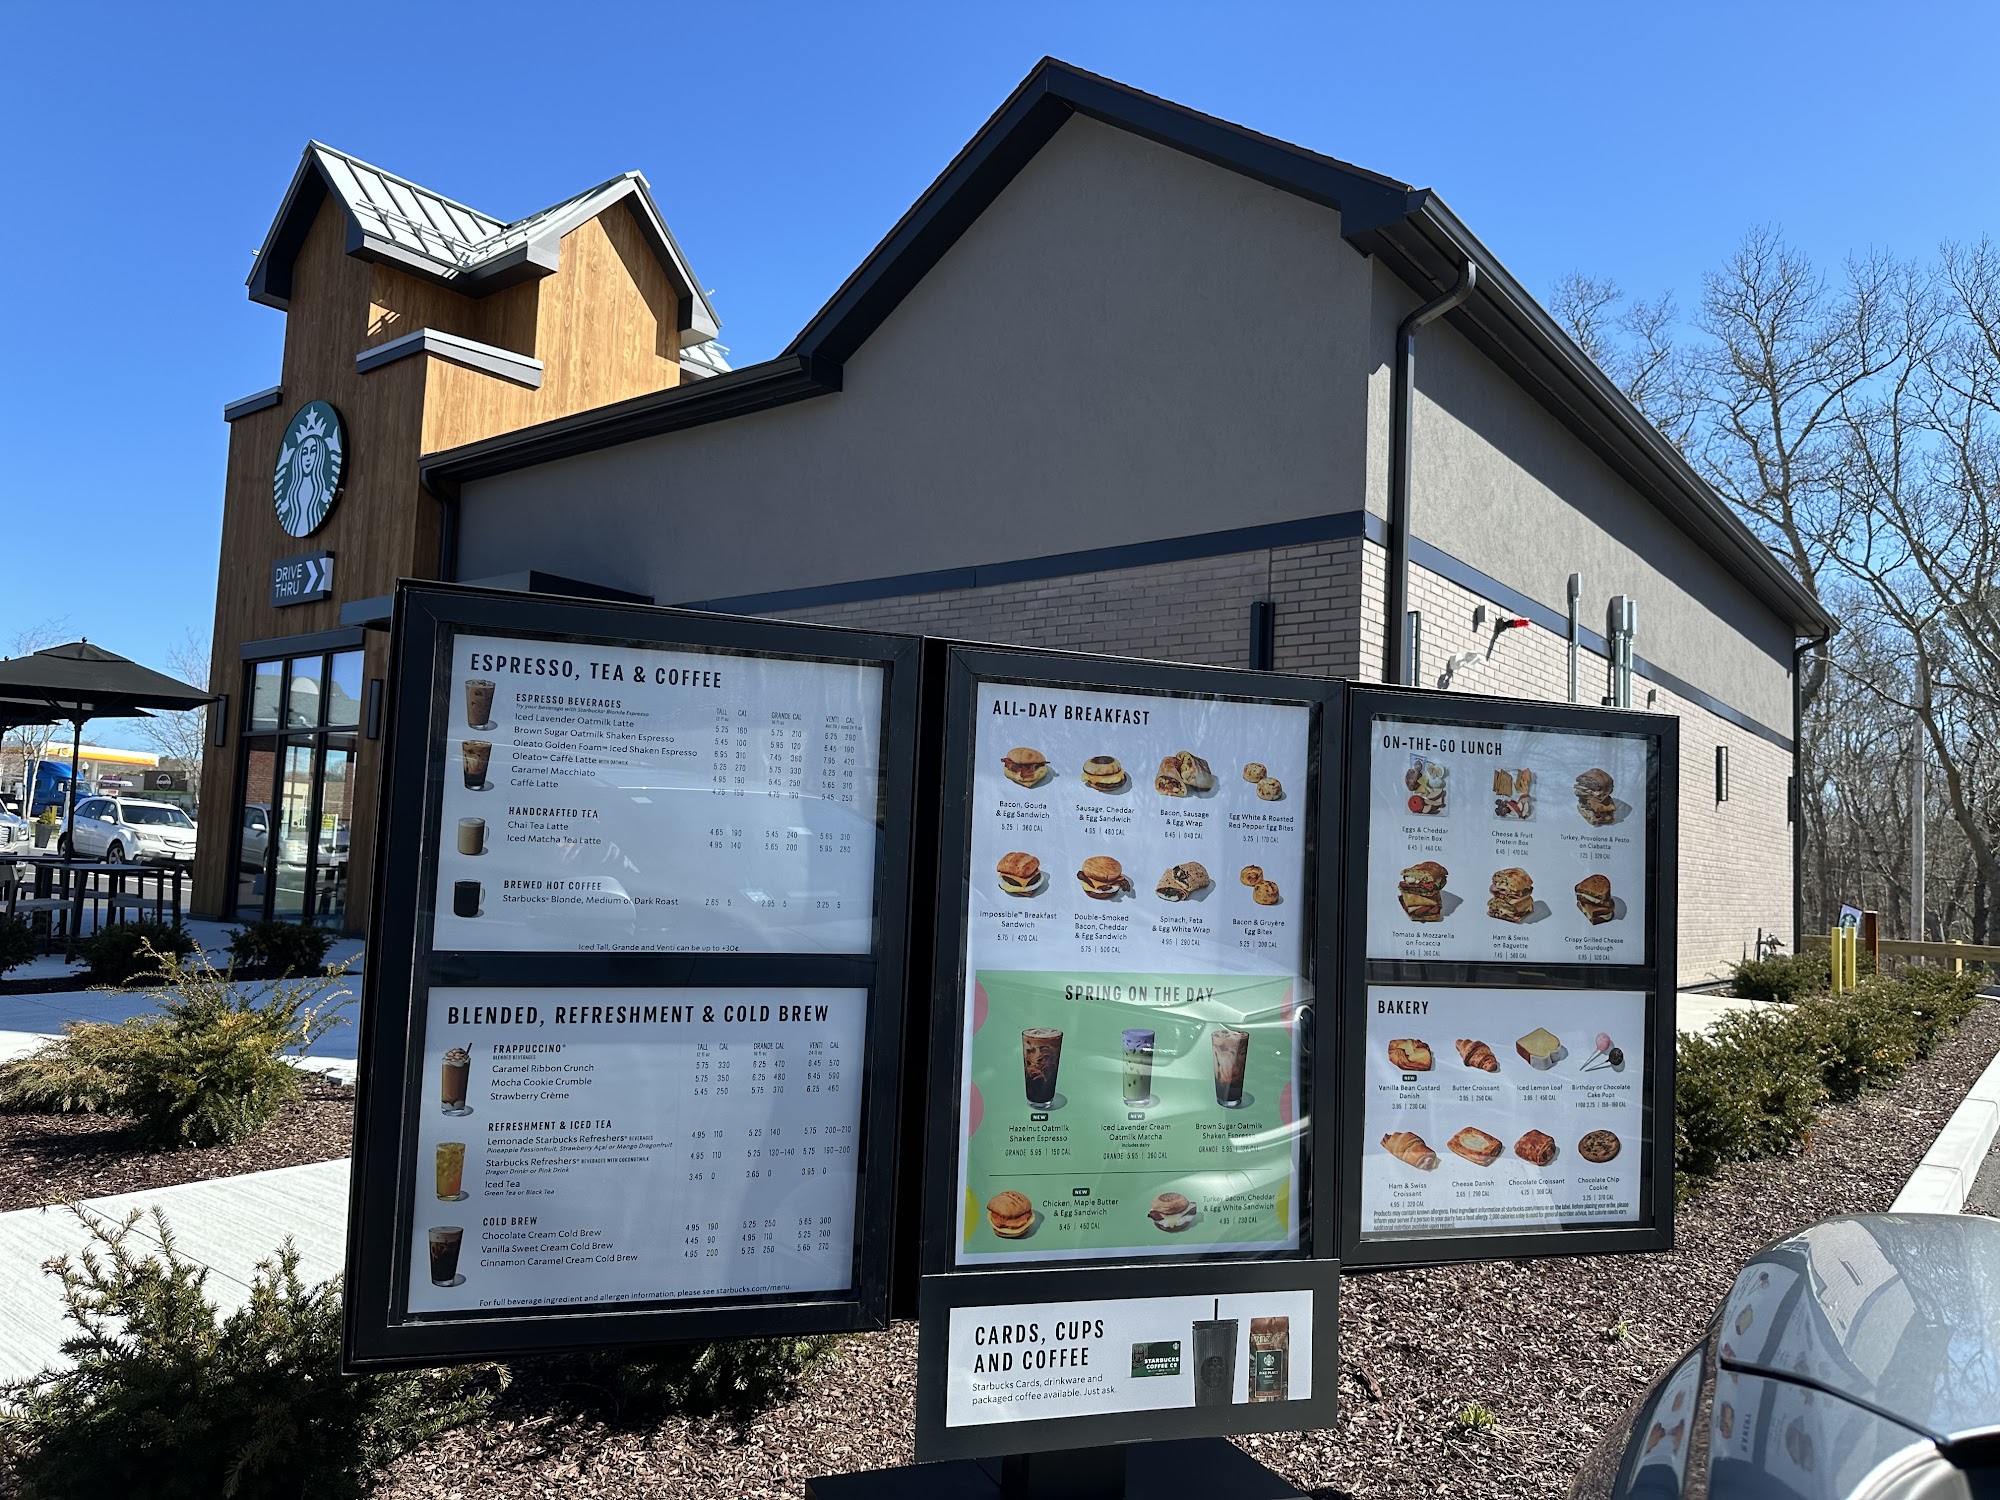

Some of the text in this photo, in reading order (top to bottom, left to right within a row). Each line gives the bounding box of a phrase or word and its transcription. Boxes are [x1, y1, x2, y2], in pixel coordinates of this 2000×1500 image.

[276, 564, 302, 582] DRIVE
[275, 581, 299, 597] THRU
[471, 654, 722, 688] ESPRESSO, TEA & COFFEE
[516, 694, 621, 708] ESPRESSO BEVERAGES
[993, 700, 1149, 725] ALL-DAY BREAKFAST
[535, 715, 575, 724] Lavender
[577, 717, 611, 726] Oatmilk
[515, 726, 674, 743] Brown Sugar Oatmilk Shaken Espresso
[1384, 735, 1502, 755] ON-THE-GO LUNCH
[550, 754, 573, 762] Caffè
[575, 755, 597, 763] Latte
[512, 766, 596, 777] Caramel Macchiato
[511, 778, 559, 788] Caffè Latte
[1000, 801, 1022, 809] Bacon,
[509, 807, 598, 818] HANDCRAFTED TEA
[1003, 811, 1015, 819] Egg
[1017, 811, 1049, 819] Sandwich
[508, 821, 528, 829] Chai
[528, 835, 560, 843] Matcha
[504, 880, 601, 890] BREWED HOT COFFEE
[552, 896, 583, 904] Blonde,
[635, 897, 652, 905] Dark
[1065, 985, 1213, 1002] SPRING ON THE DAY
[1378, 1001, 1428, 1014] BAKERY
[448, 1005, 828, 1027] BLENDED, REFRESHMENT & COLD BREW
[531, 1064, 562, 1072] Ribbon
[563, 1063, 594, 1072] Crunch
[491, 1077, 592, 1087] Mocha Cookie Crumble
[491, 1092, 538, 1101] Strawberry
[488, 1120, 611, 1131] REFRESHMENT & ICED TEA
[692, 1131, 705, 1139] 4.95
[486, 1158, 529, 1167] Starbucks
[485, 1180, 503, 1188] Iced
[1061, 1210, 1072, 1218] Egg
[483, 1216, 538, 1226] COLD BREW
[482, 1229, 601, 1240] Chocolate Cream Cold Brew
[482, 1245, 509, 1253] Vanilla
[512, 1244, 538, 1253] Sweet
[571, 1242, 589, 1250] Cold
[481, 1254, 638, 1267] Cinnamon Caramel Cream Cold Brew
[975, 1319, 1104, 1345] CARDS, CUPS
[974, 1348, 1088, 1373] AND COFFEE
[972, 1374, 1103, 1391] Starbucks Cards, drinkware and
[972, 1386, 1117, 1406] packaged coffee available. Just ask.
